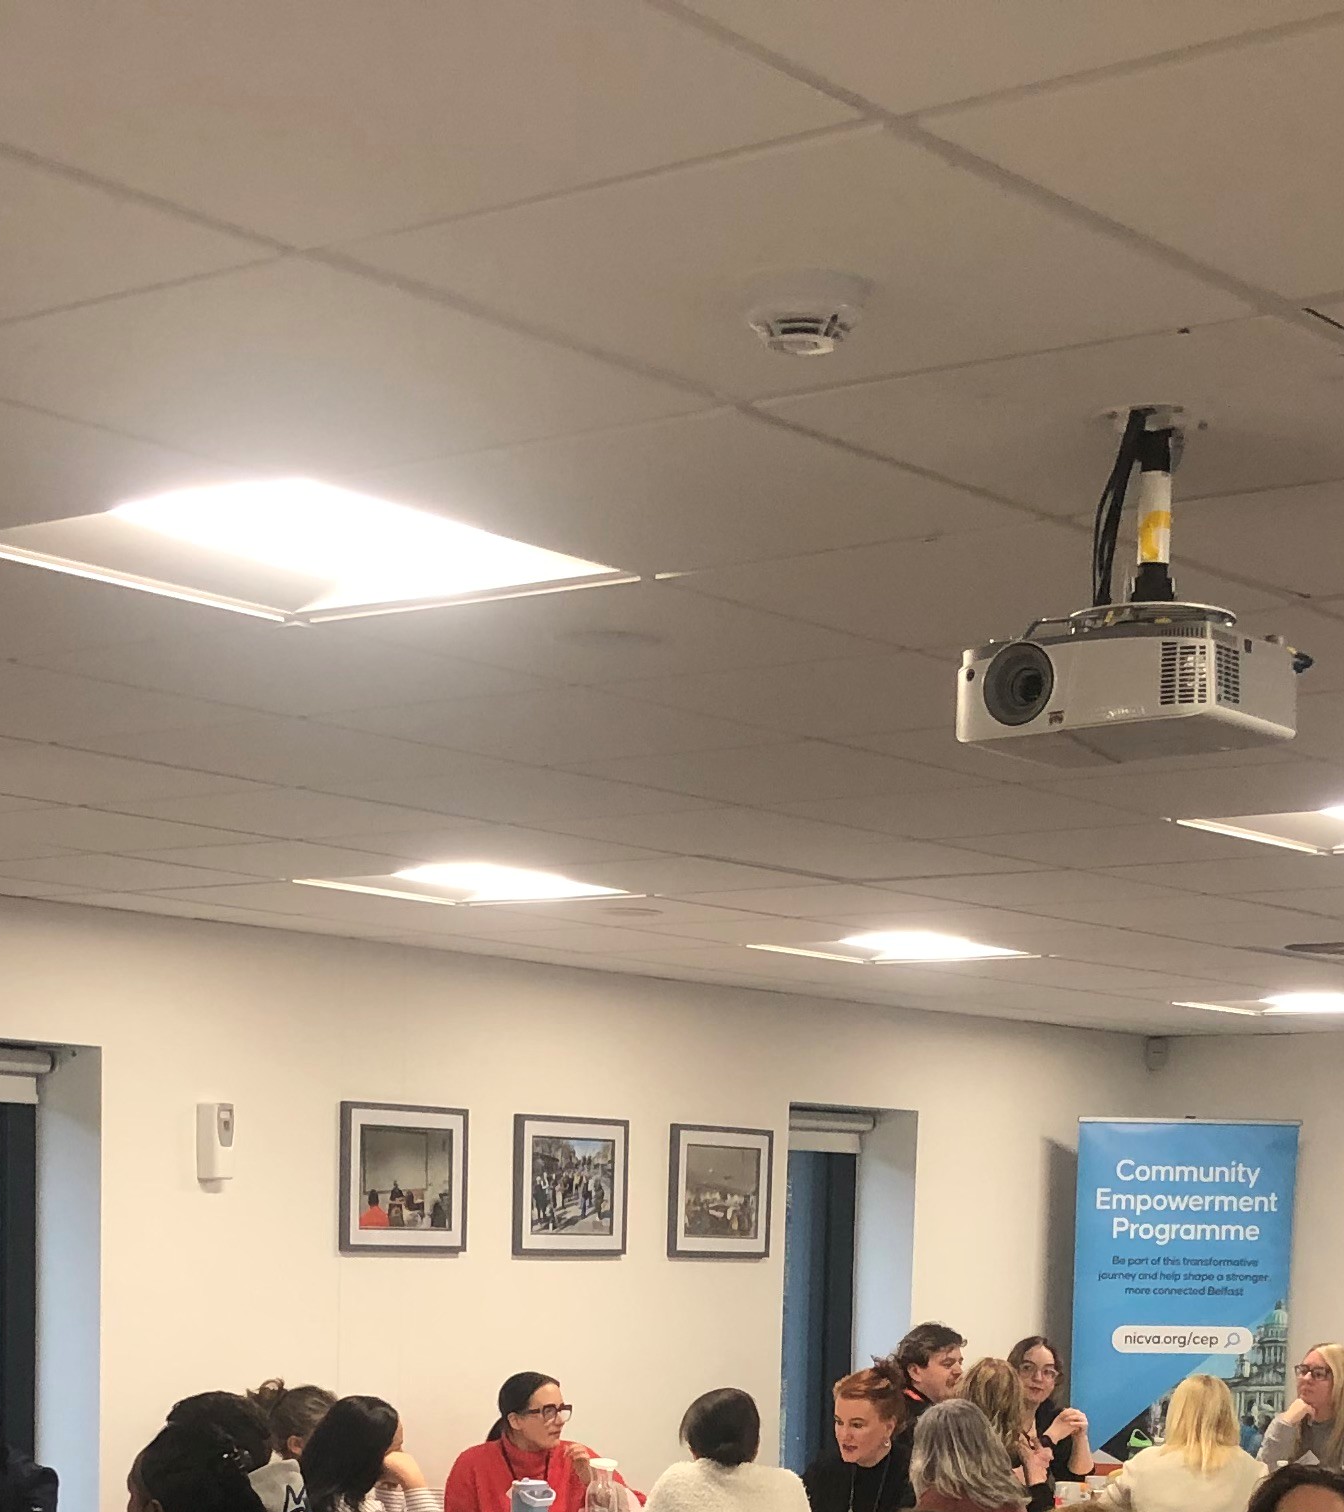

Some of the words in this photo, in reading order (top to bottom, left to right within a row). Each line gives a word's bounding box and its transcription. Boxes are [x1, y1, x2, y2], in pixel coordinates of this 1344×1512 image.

[1116, 1159, 1260, 1188] Community
[1095, 1187, 1278, 1216] Empowerment
[1112, 1217, 1260, 1246] Programme
[1112, 1255, 1126, 1265] Be
[1127, 1256, 1149, 1267] part
[1150, 1256, 1162, 1266] of
[1163, 1257, 1181, 1266] this
[1182, 1257, 1258, 1267] transformative
[1097, 1271, 1136, 1281] journey
[1138, 1271, 1157, 1280] and
[1159, 1270, 1181, 1282] help
[1183, 1272, 1215, 1282] shape
[1216, 1273, 1224, 1281] a
[1124, 1286, 1151, 1295] more
[1152, 1286, 1206, 1295] connected
[1207, 1286, 1244, 1296] Belfast
[1124, 1331, 1219, 1348] nicva.org/cep
